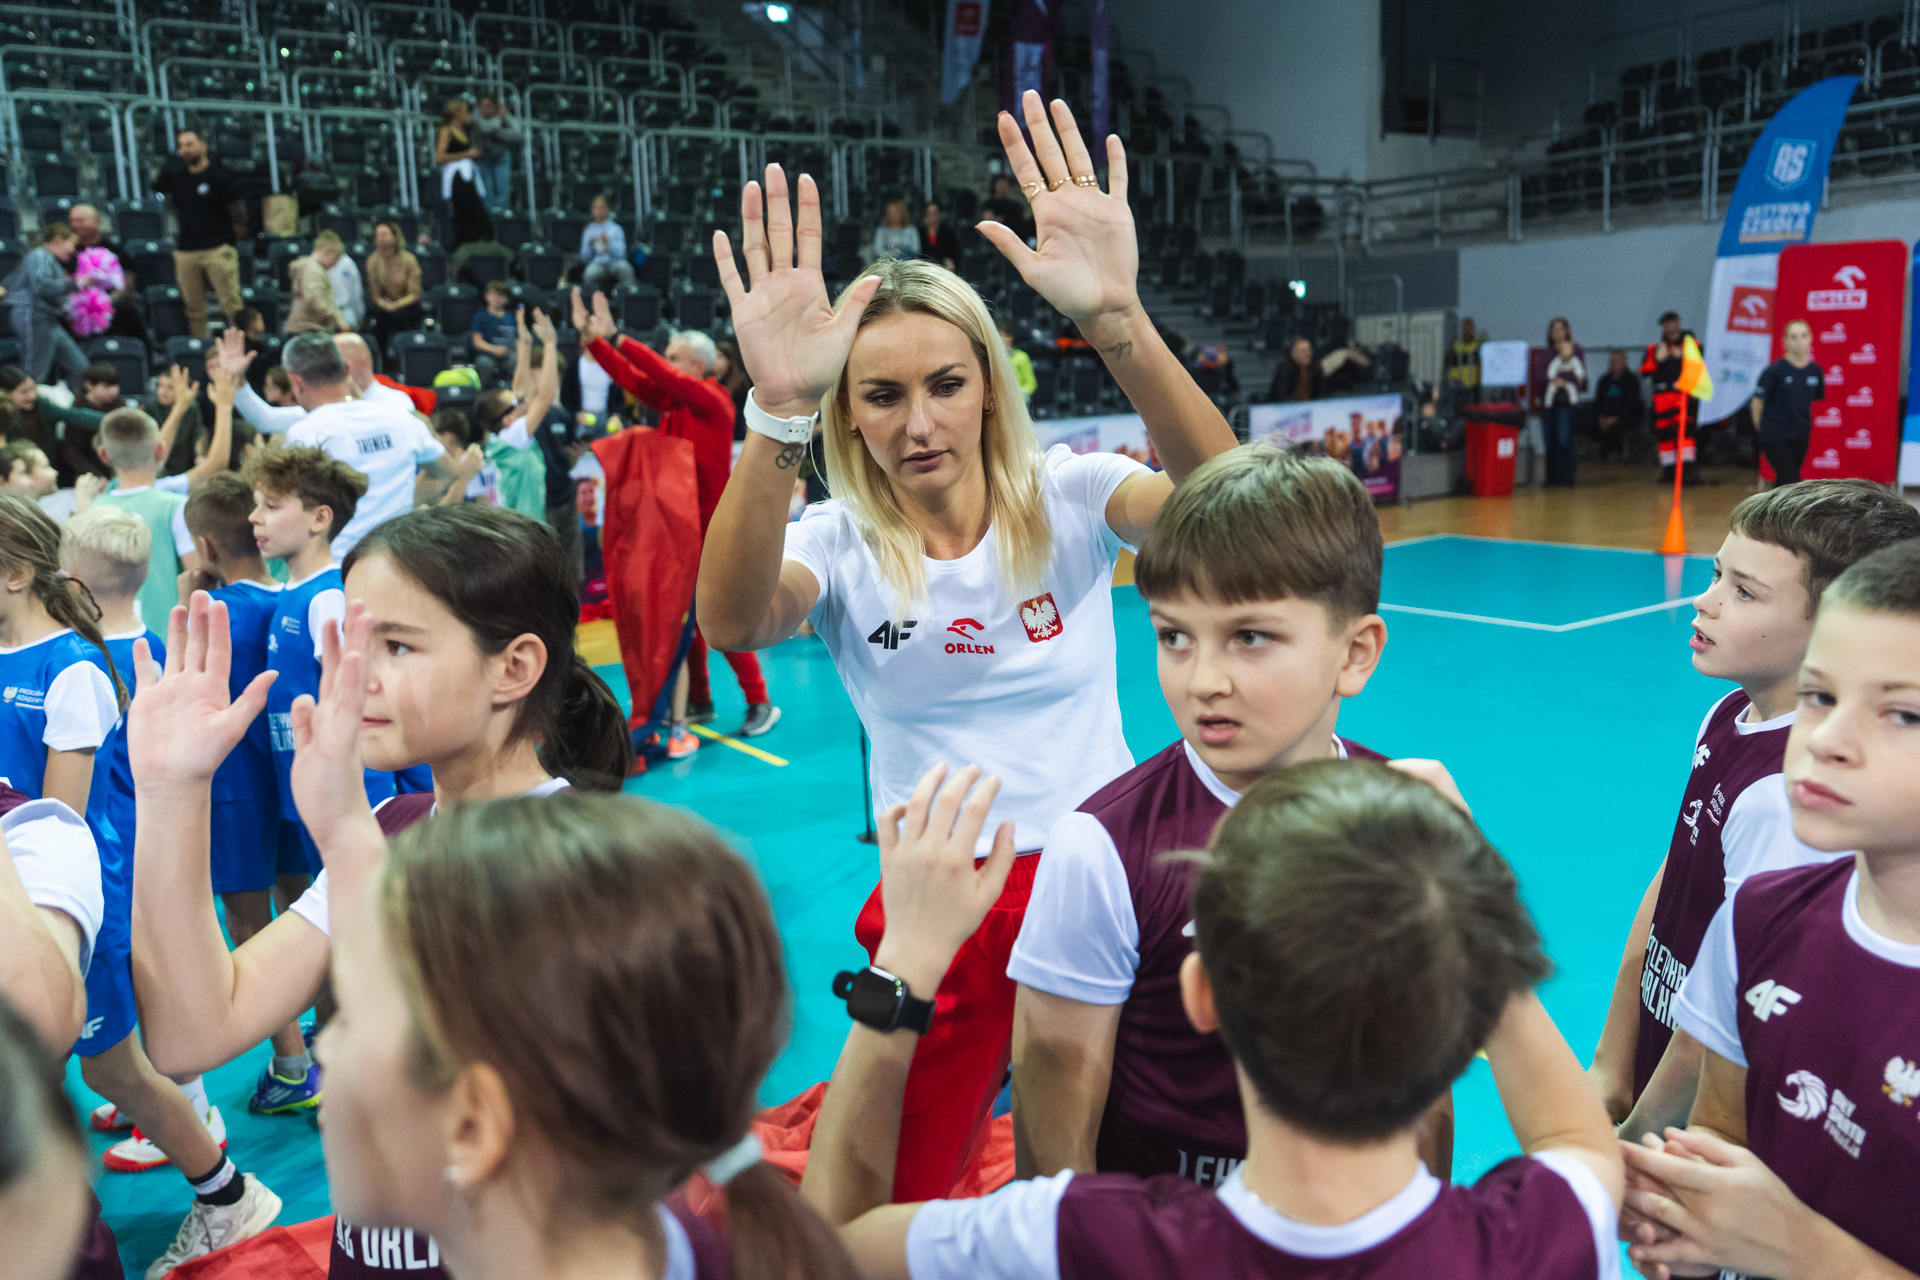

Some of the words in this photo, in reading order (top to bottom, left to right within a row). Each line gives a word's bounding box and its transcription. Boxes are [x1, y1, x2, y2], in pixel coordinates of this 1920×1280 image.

[356, 434, 394, 454] TRENER
[868, 620, 918, 650] 4F
[945, 643, 995, 655] ORLEN
[1744, 979, 1803, 1022] 4F
